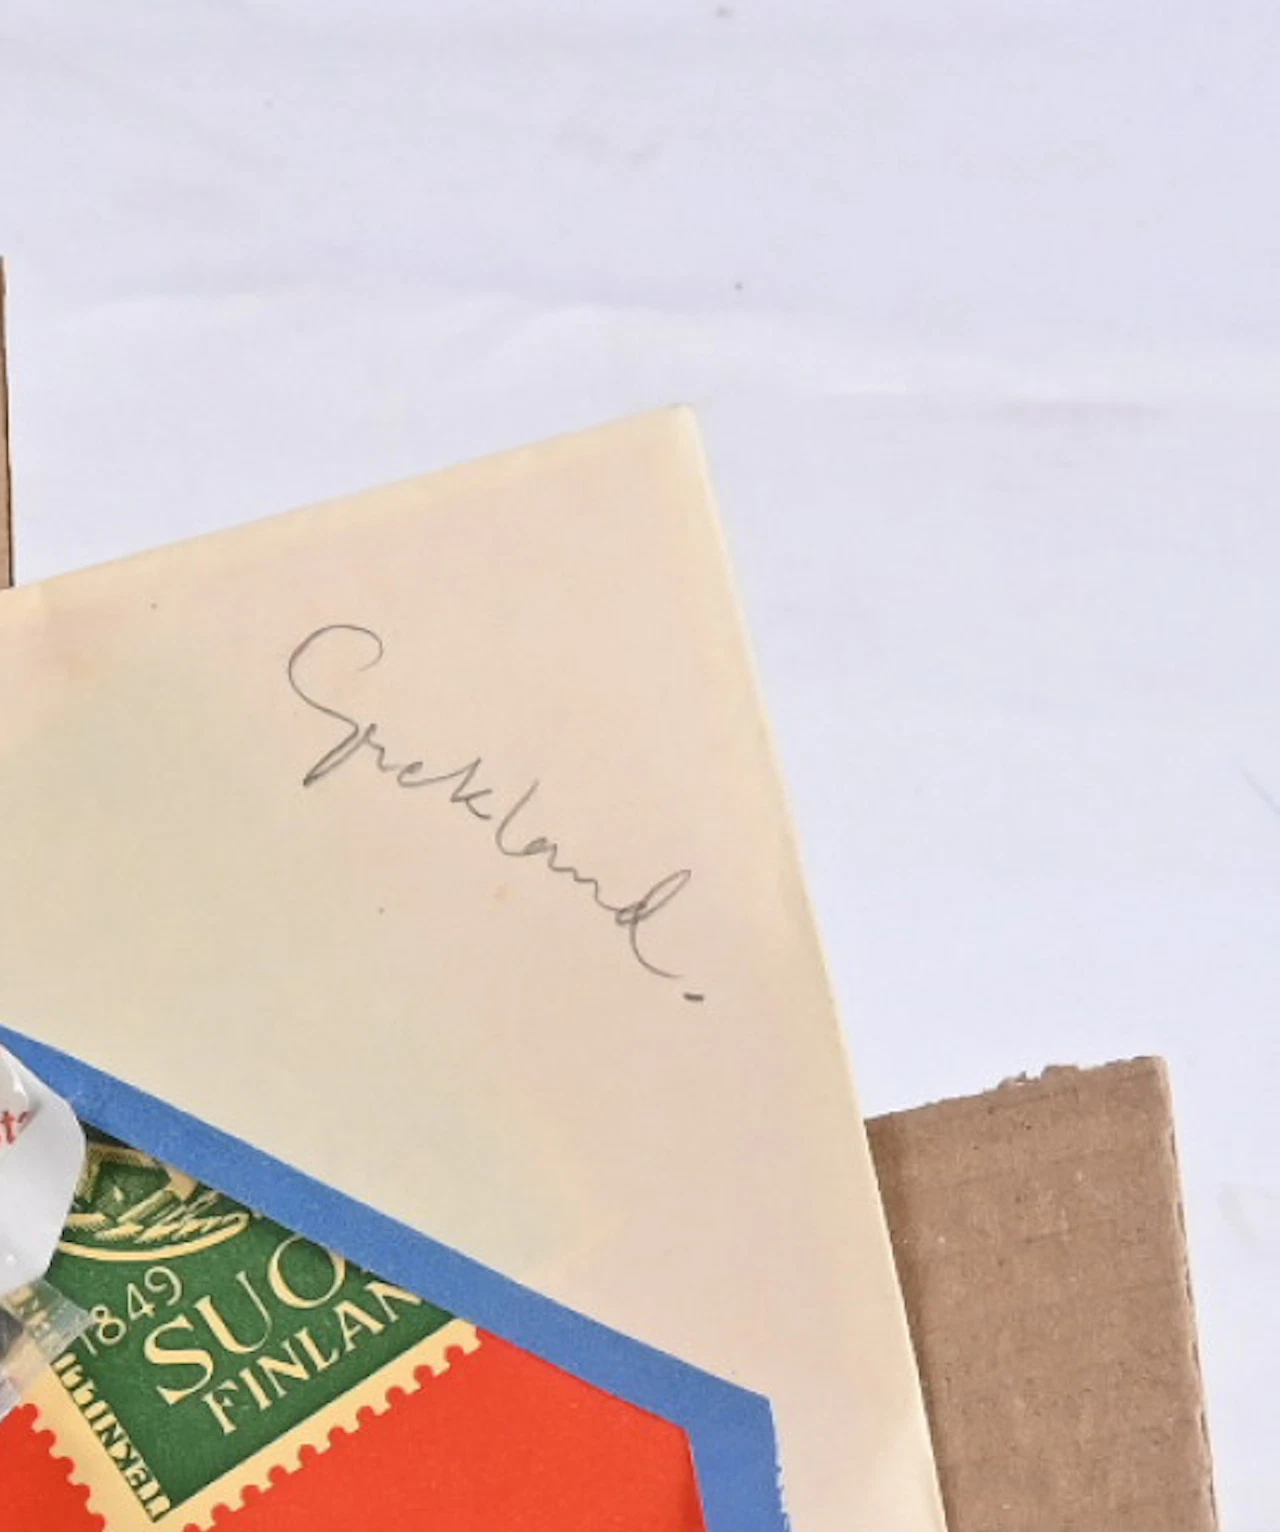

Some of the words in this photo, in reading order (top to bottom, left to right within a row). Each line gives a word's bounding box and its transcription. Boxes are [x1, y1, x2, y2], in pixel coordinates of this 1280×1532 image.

[79, 1265, 183, 1357] 1849
[143, 1235, 346, 1405] SUO
[201, 1281, 423, 1434] FINLAN
